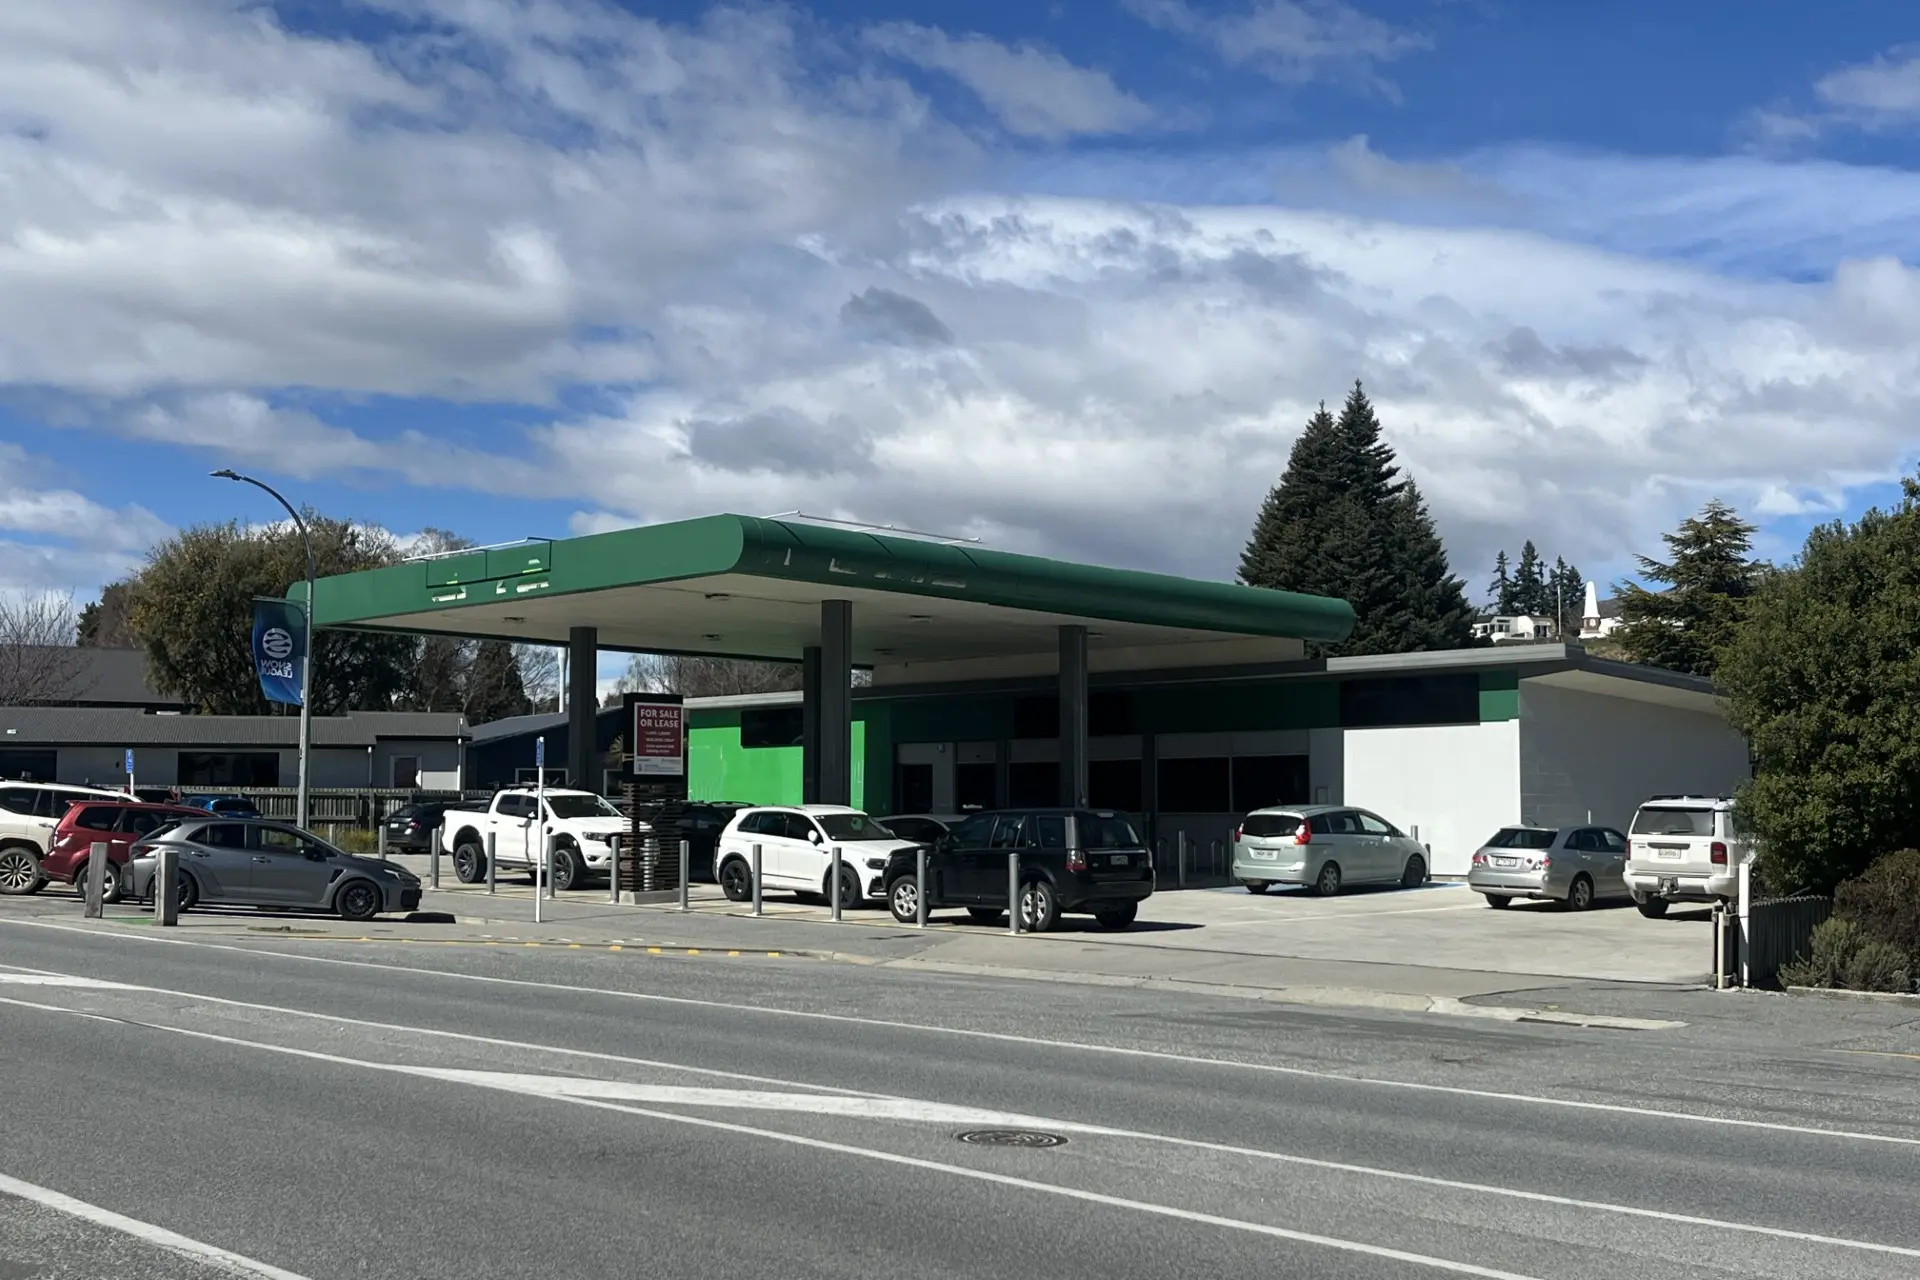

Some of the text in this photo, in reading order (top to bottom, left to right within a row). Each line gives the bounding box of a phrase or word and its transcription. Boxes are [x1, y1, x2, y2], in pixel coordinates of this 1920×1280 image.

[640, 709, 679, 718] FOR SALE
[640, 719, 679, 728] OR LEASE
